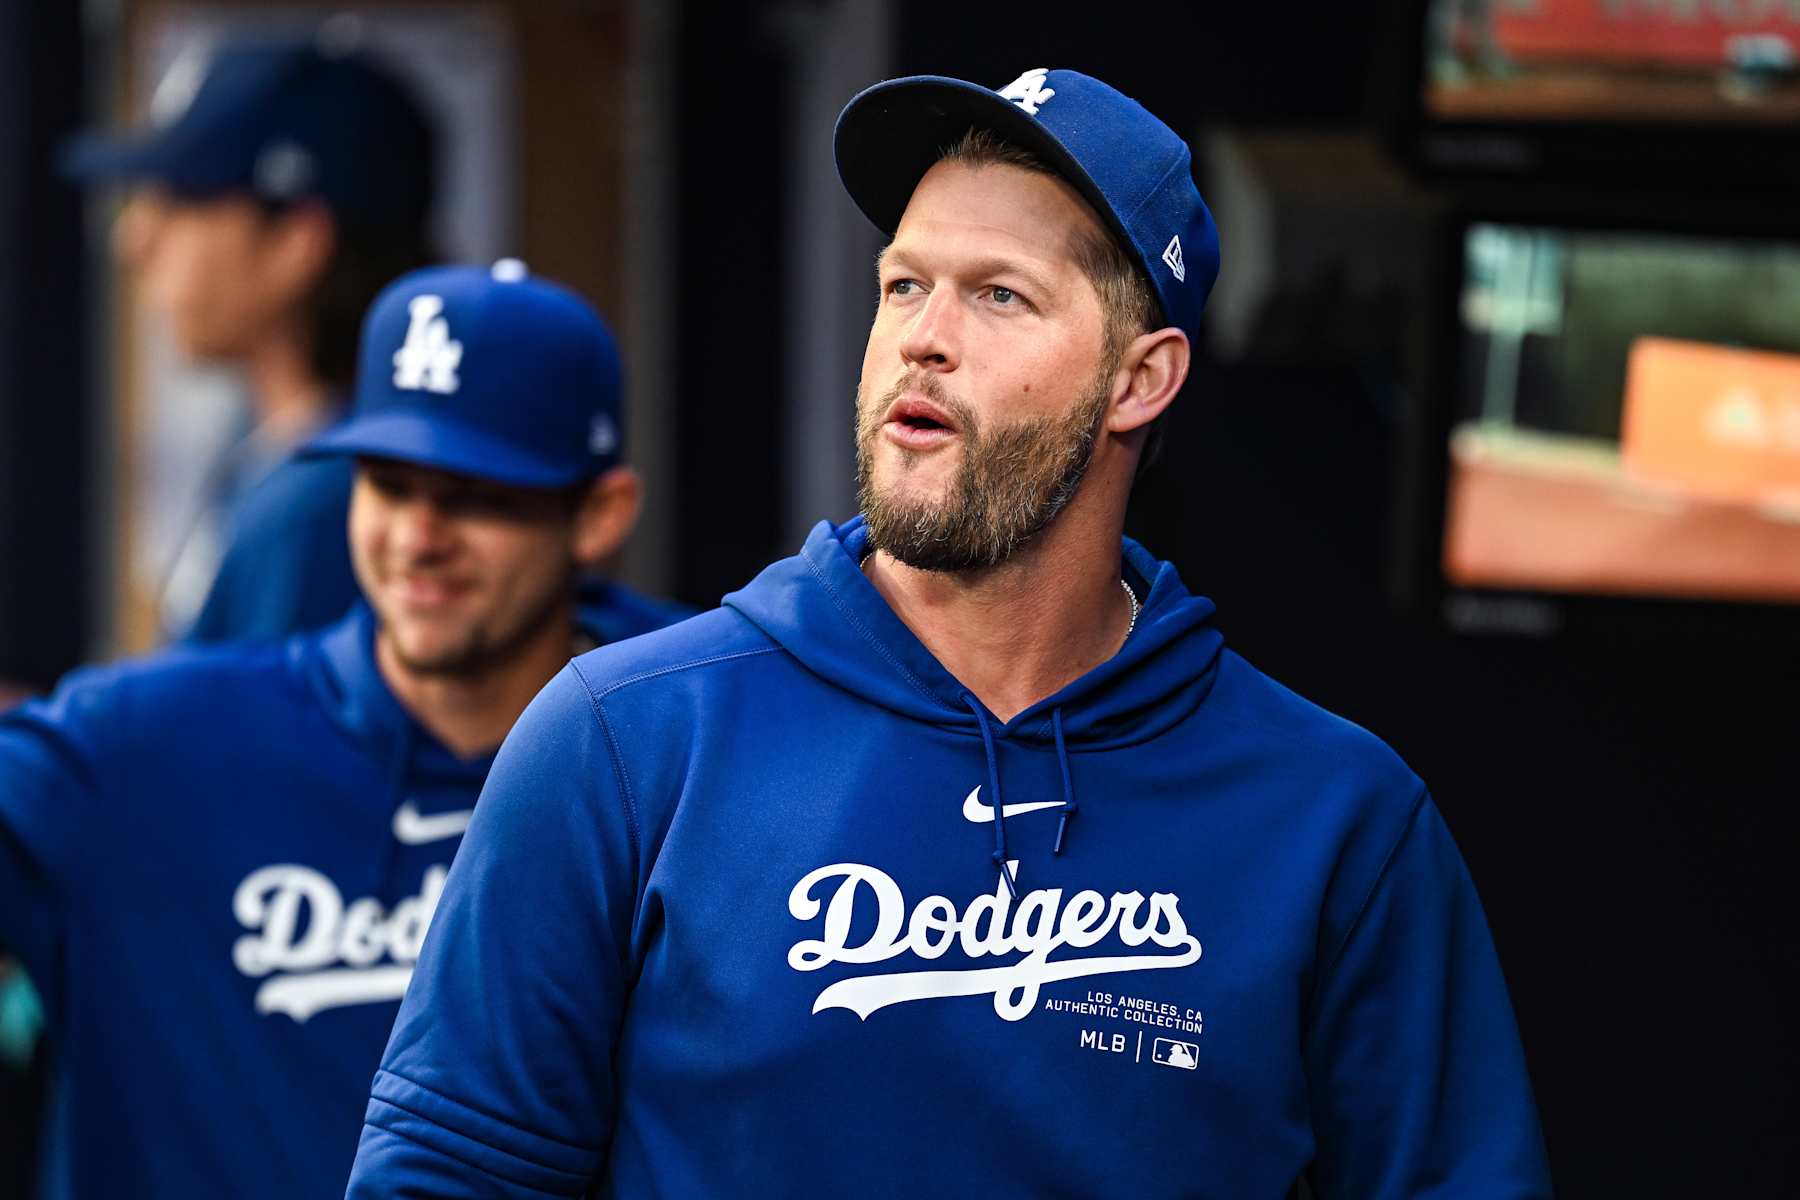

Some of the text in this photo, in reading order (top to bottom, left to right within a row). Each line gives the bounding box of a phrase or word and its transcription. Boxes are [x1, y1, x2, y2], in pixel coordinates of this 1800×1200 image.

[393, 294, 463, 393] LA
[787, 859, 1202, 1022] Dodgers
[1045, 999, 1203, 1034] AUTHENTIC COLLECTION
[1087, 991, 1113, 1005] LOS
[1186, 1008, 1203, 1022] CA
[1080, 1029, 1126, 1053] MLB
